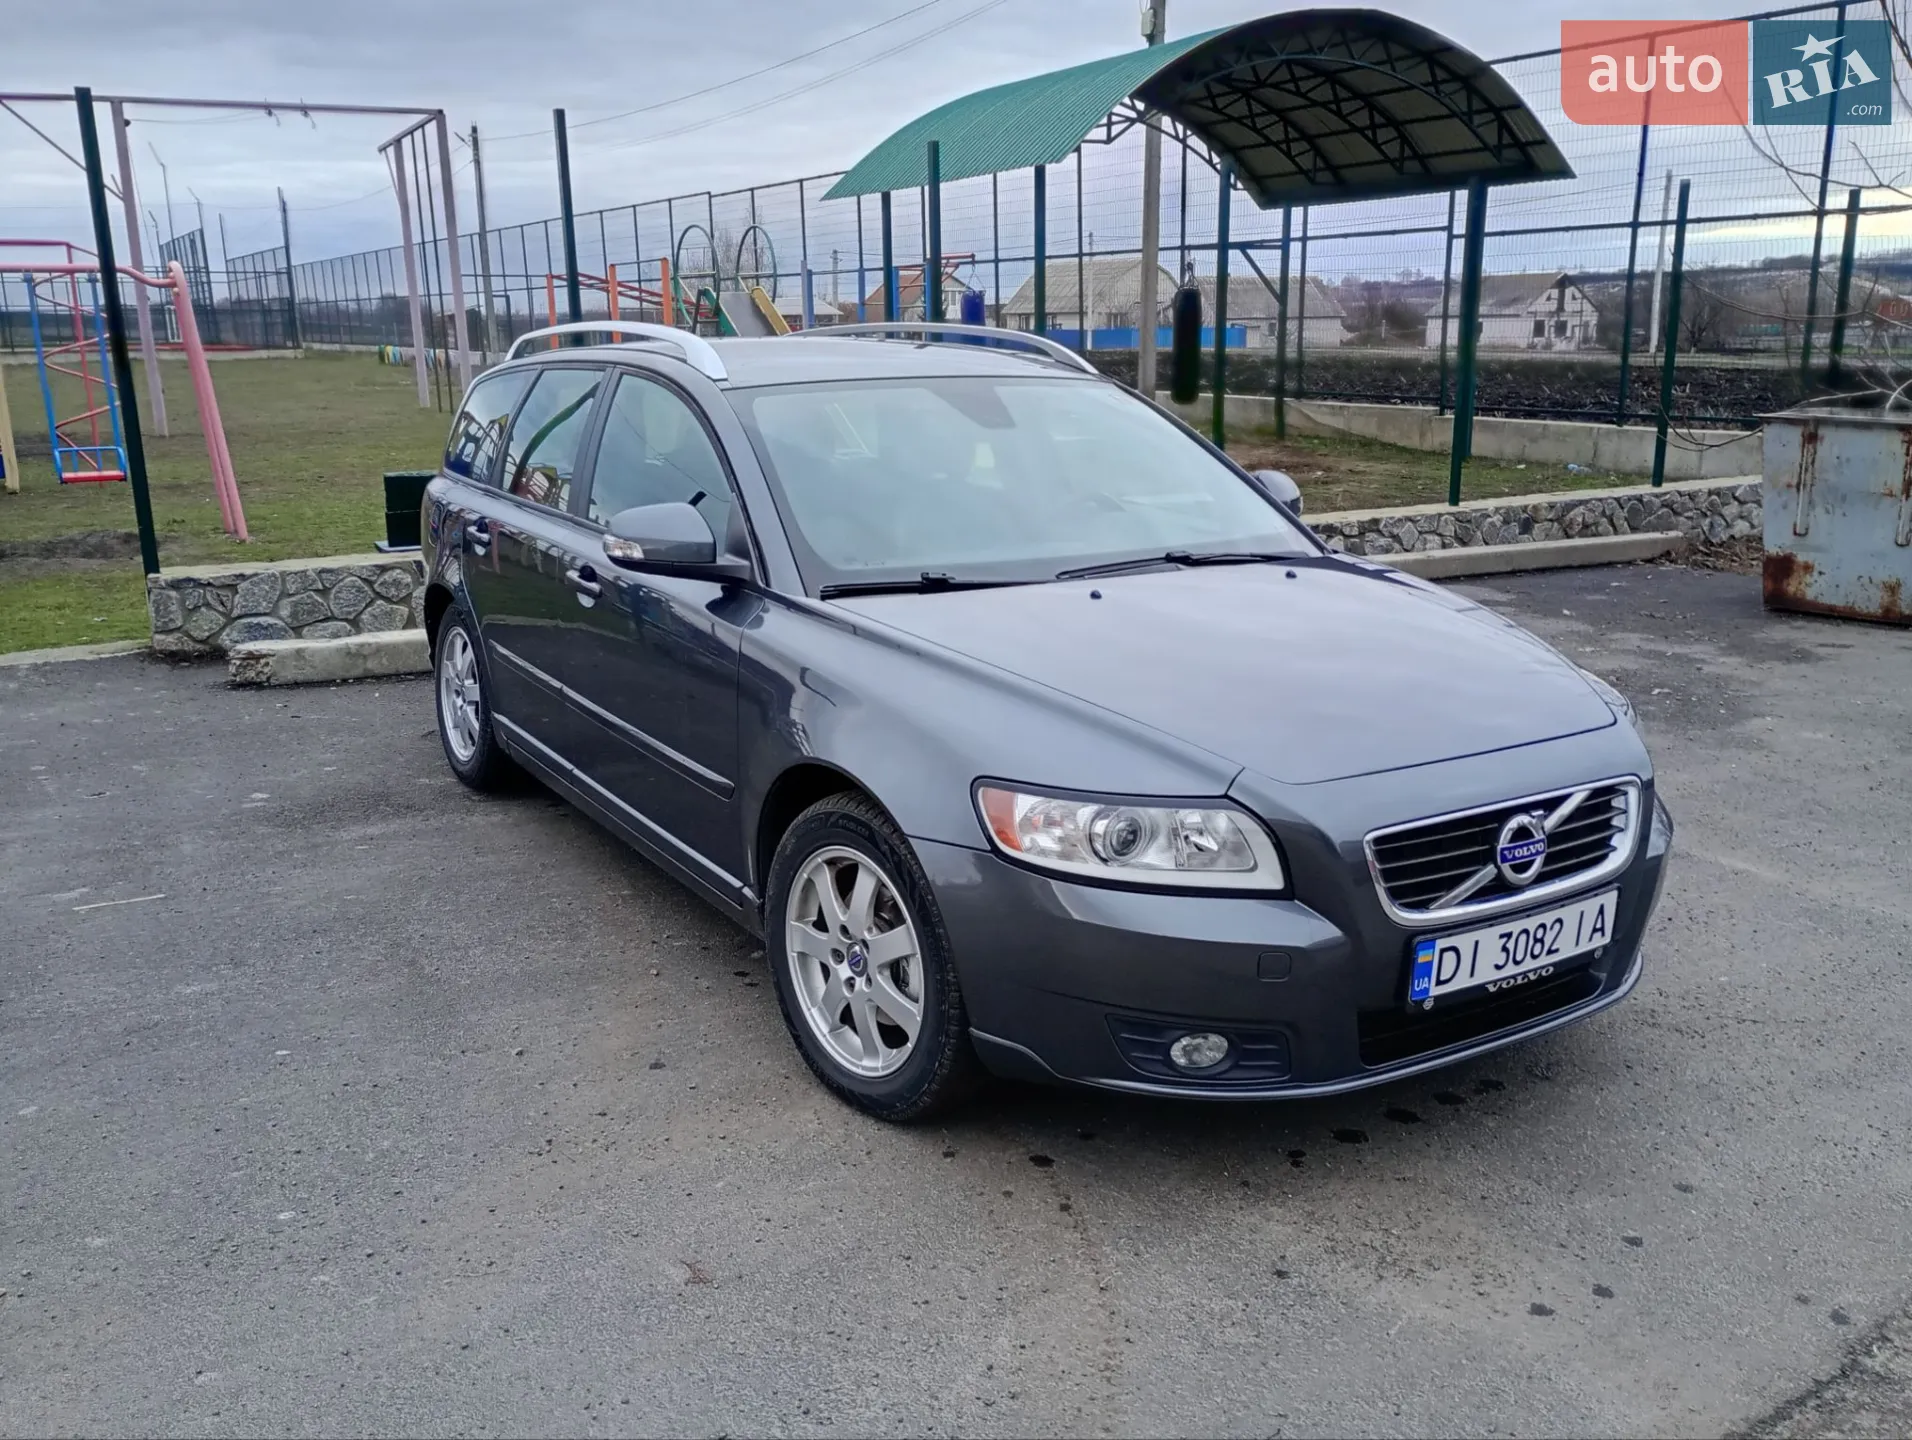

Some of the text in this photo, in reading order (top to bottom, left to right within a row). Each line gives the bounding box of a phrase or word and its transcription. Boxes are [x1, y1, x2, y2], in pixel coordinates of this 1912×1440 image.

[1503, 842, 1545, 859] VOLVO
[1434, 904, 1606, 987] DI 3082 IA
[1414, 976, 1430, 992] UA
[1486, 966, 1555, 993] VOLVO
